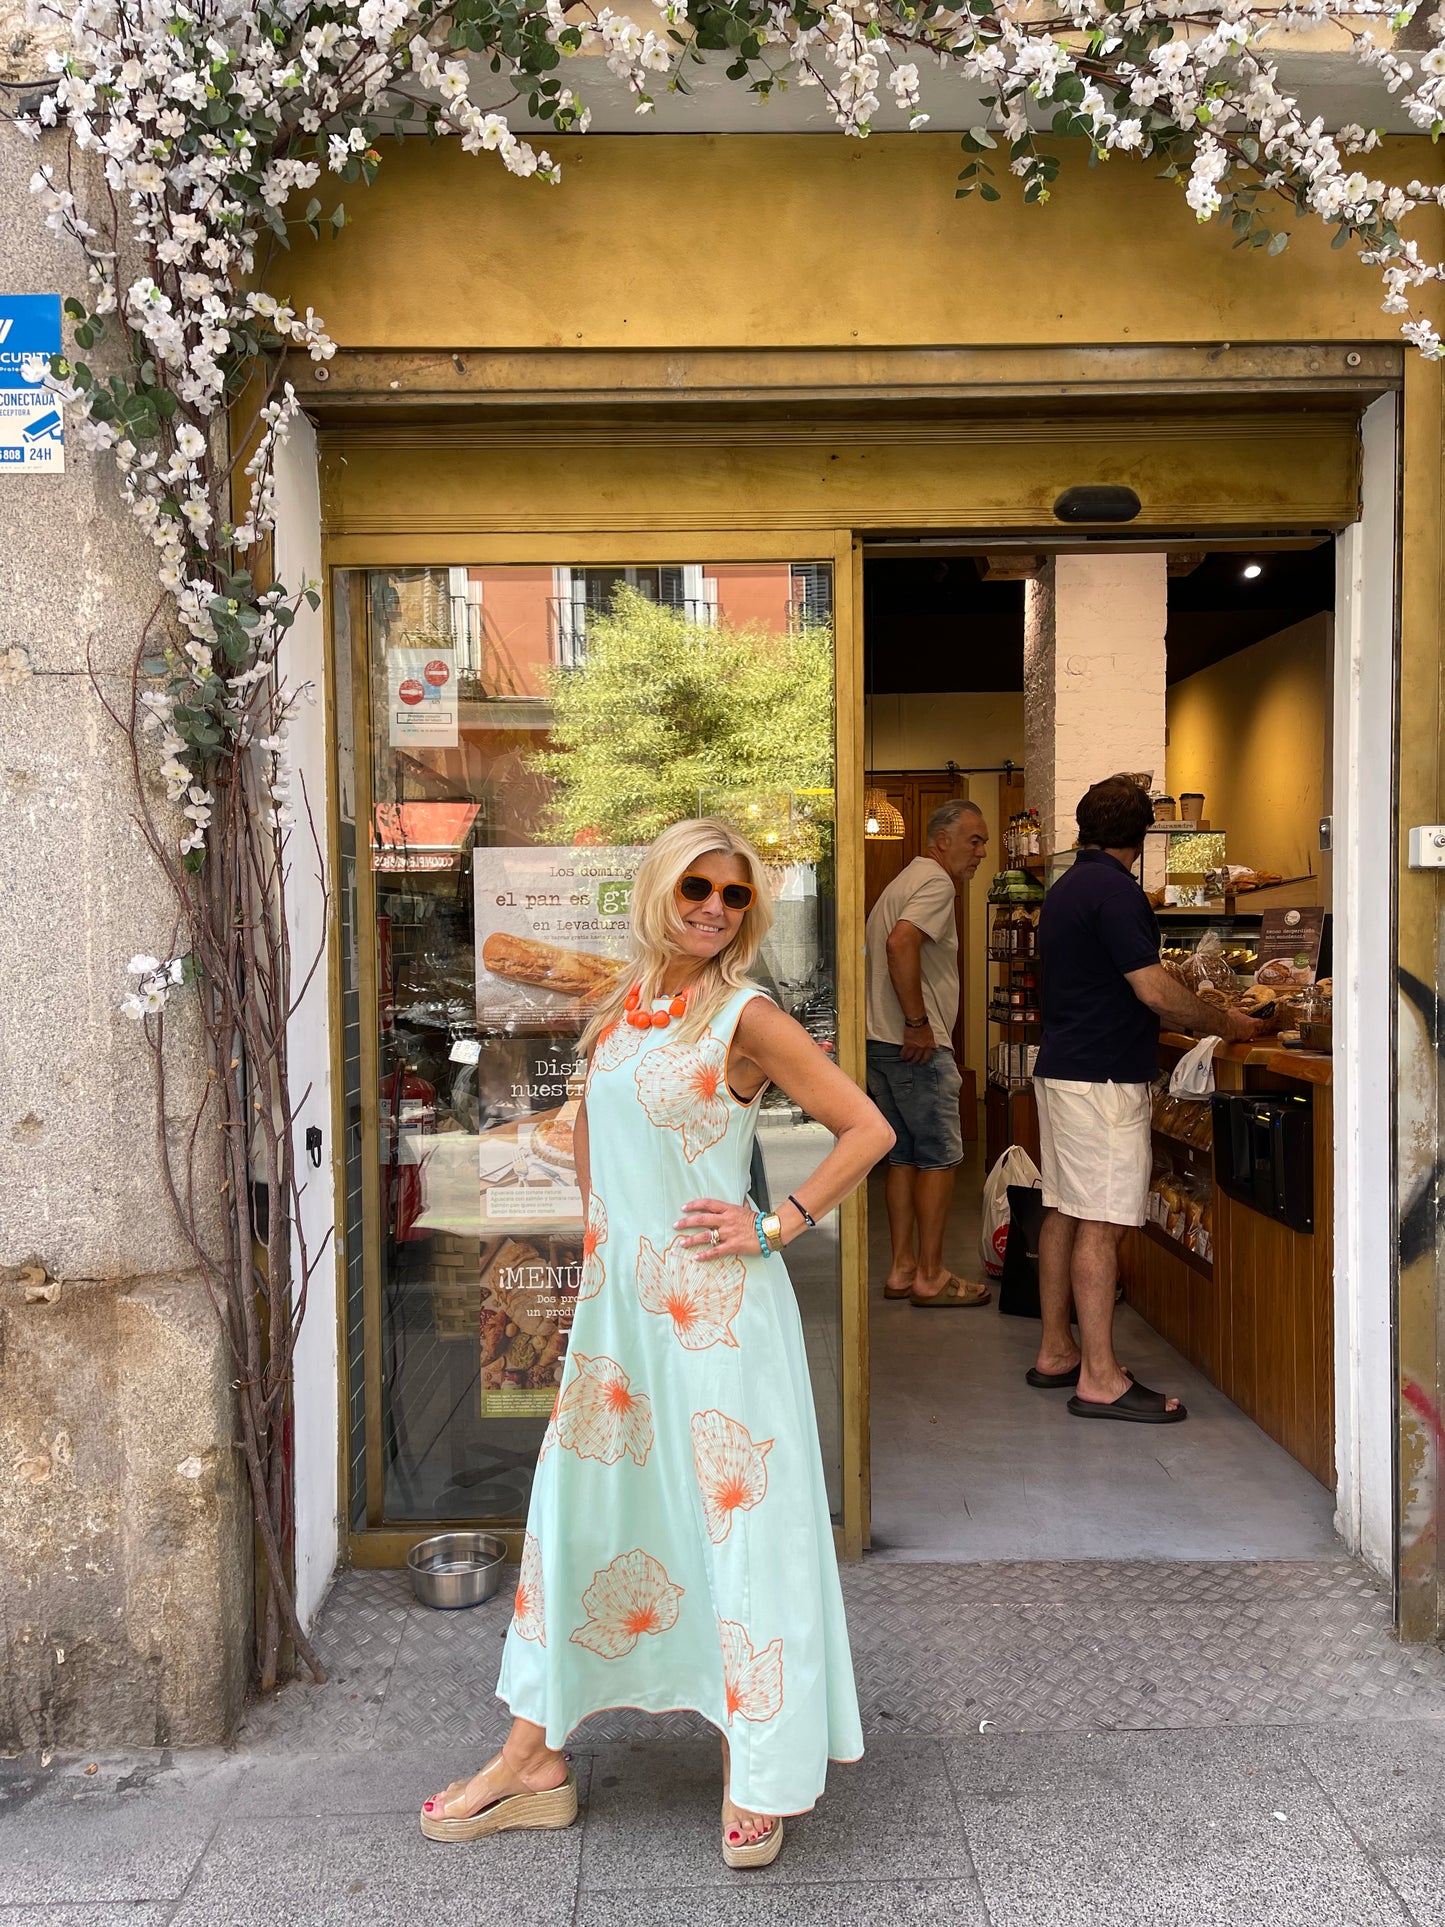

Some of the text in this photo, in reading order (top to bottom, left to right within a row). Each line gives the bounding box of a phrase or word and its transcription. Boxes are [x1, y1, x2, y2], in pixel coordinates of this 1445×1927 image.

[0, 393, 56, 406] CONECTADA
[30, 448, 52, 460] 24H
[550, 866, 575, 877] Los
[496, 888, 633, 913] el pan es gr
[532, 921, 551, 931] en
[535, 1058, 588, 1077] Disf
[498, 1261, 583, 1290] ¡MENÚ
[537, 1294, 556, 1304] Dos
[526, 1309, 541, 1317] un
